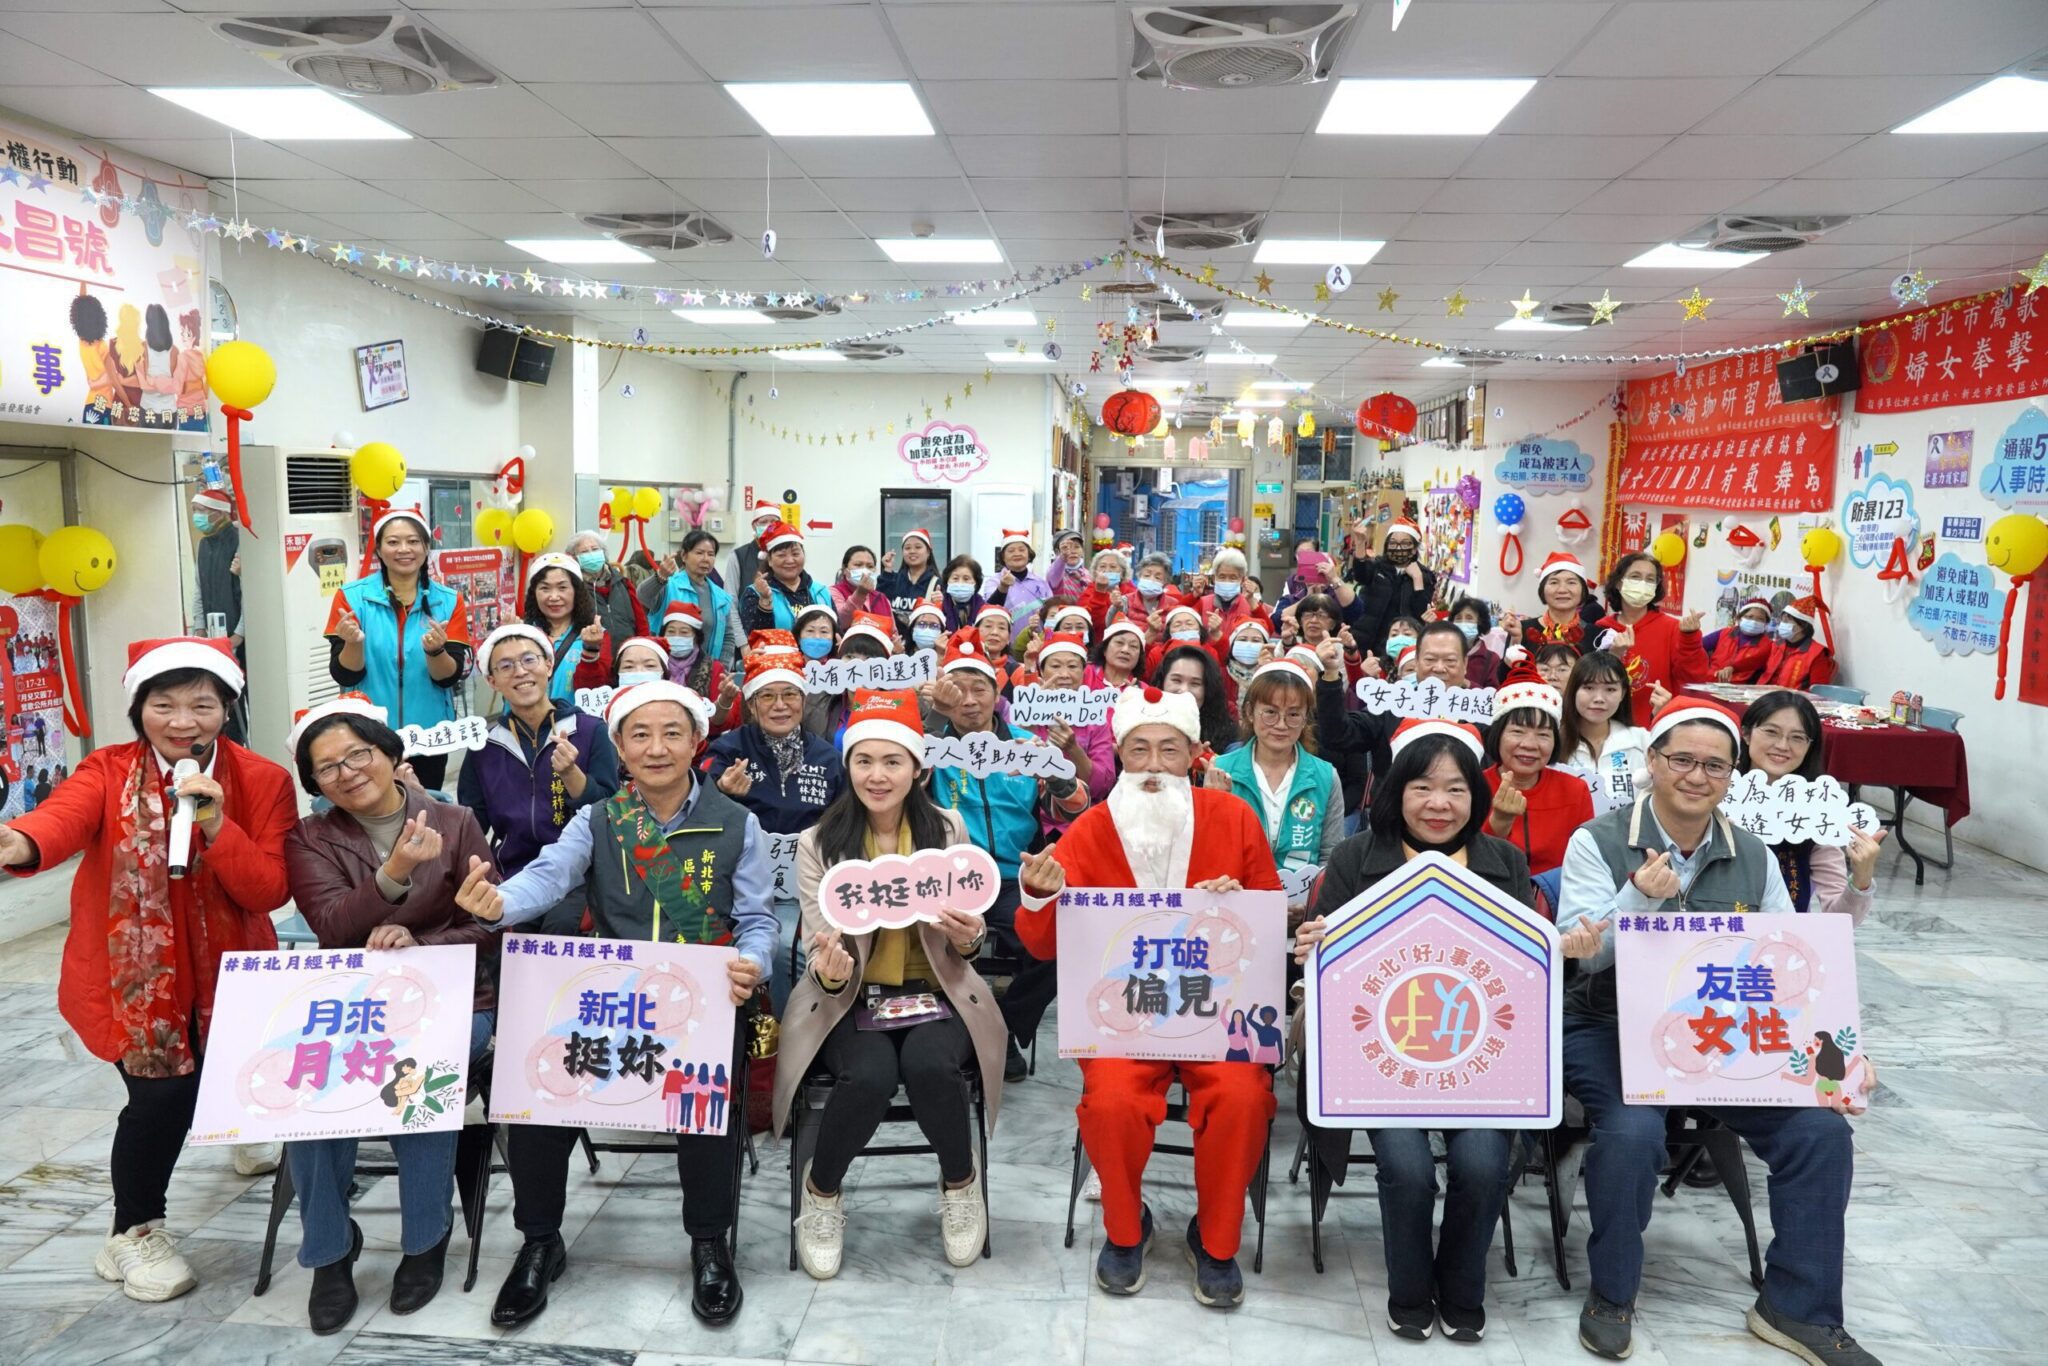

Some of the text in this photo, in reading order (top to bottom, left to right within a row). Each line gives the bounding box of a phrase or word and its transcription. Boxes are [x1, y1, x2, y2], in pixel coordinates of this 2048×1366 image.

[0, 139, 79, 186] 權行動
[0, 199, 113, 273] 昌號
[32, 343, 66, 395] 事
[1904, 330, 2048, 388] 婦女拳擊
[95, 395, 206, 425] 邀請您共同響應
[921, 434, 965, 448] 避免成為
[1520, 443, 1542, 456] 避免
[1519, 456, 1581, 471] 成為被害人
[1989, 465, 2048, 494] 人事時
[1851, 499, 1904, 522] 防暴123
[1937, 566, 1979, 587] 避免成為
[1017, 686, 1119, 704] Women Love
[1014, 708, 1104, 723] Women Do!
[1291, 824, 1314, 848] 彭
[1725, 807, 1870, 840] 縫「女子」事
[701, 849, 716, 895] 新北市
[1058, 892, 1184, 908] #新北月經平權
[1618, 916, 1745, 933] #新北月經平權
[223, 952, 365, 972] #新北月經平權
[506, 938, 634, 961] #新北月經平權
[1132, 935, 1210, 970] 打破
[1121, 974, 1219, 1018] 偏見
[1696, 963, 1776, 1002] 友善
[302, 998, 387, 1036] 月來
[577, 989, 657, 1030] 新北
[1687, 1005, 1794, 1057] 女性
[284, 1038, 397, 1092] 月好
[562, 1031, 668, 1084] 挺妳
